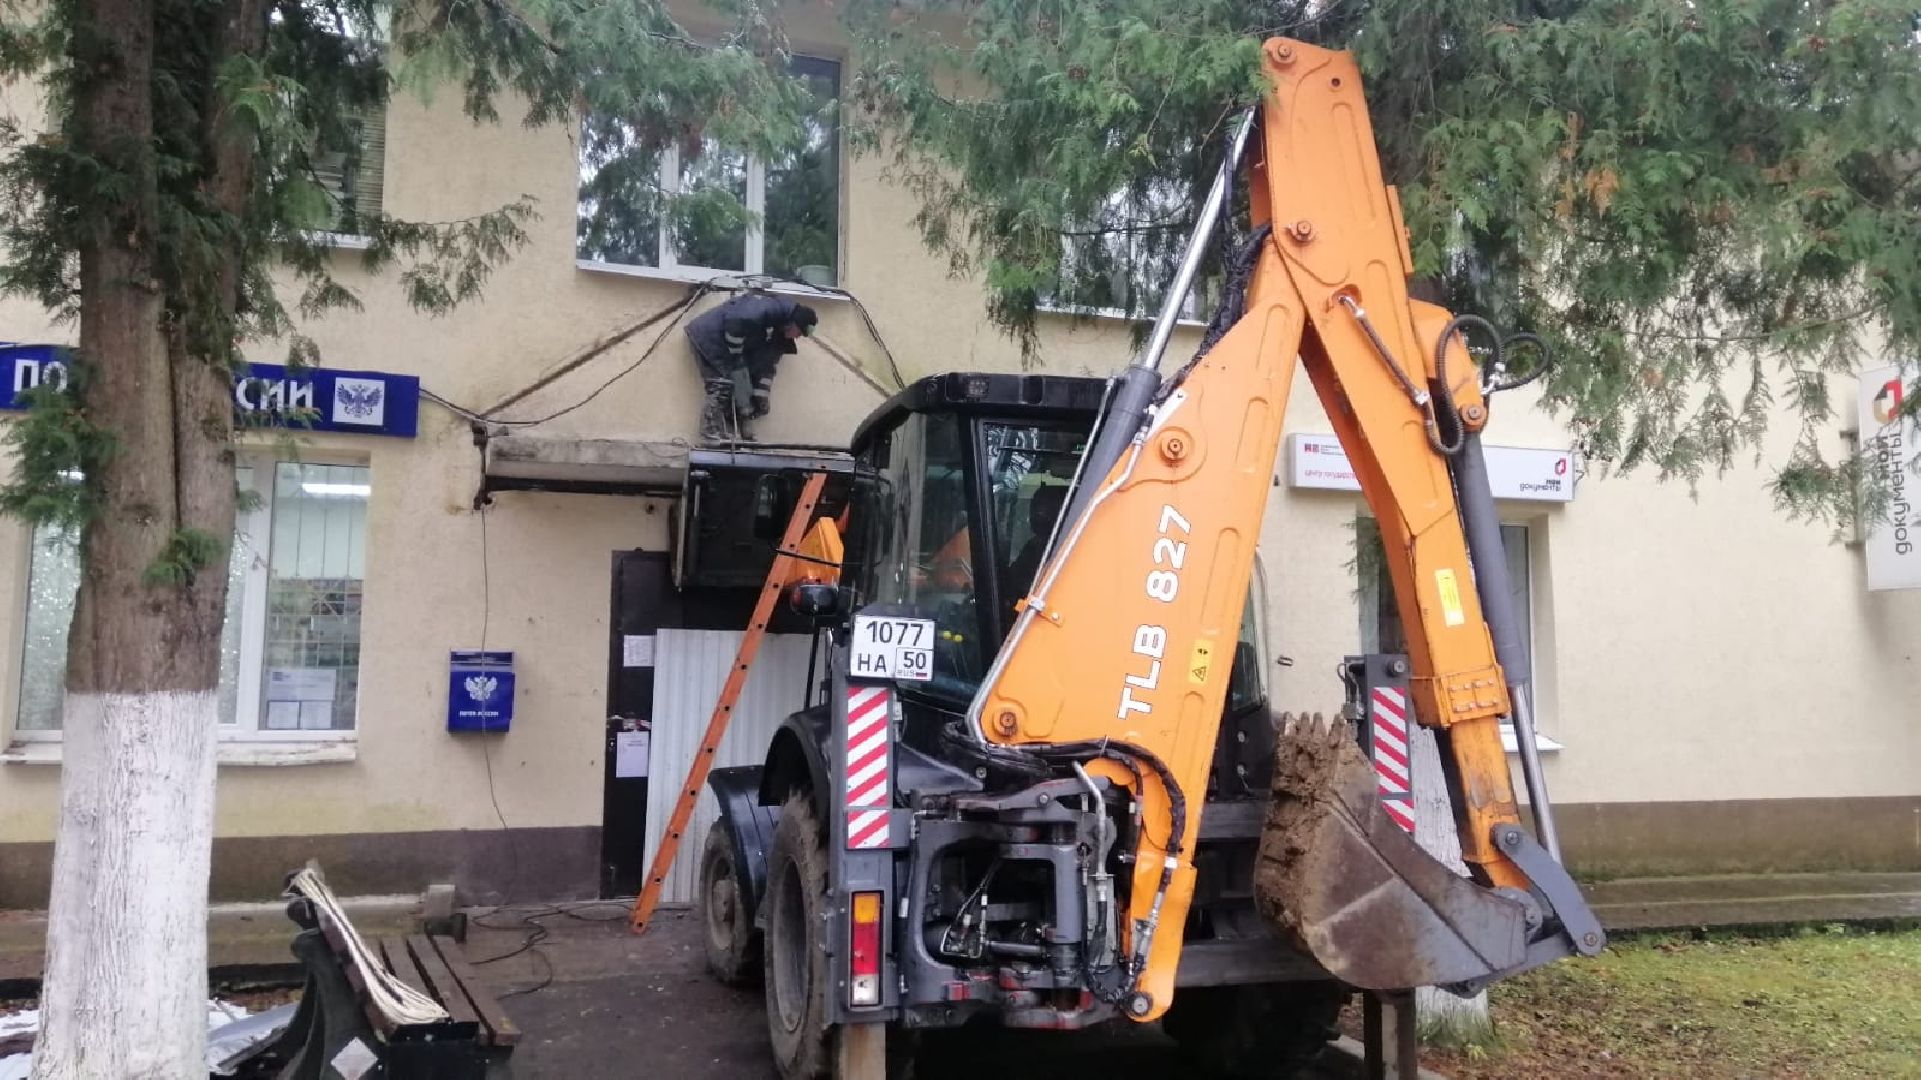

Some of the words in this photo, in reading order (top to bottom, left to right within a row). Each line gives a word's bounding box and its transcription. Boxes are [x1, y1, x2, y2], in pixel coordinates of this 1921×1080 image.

[13, 359, 68, 395] ПО
[235, 376, 314, 413] СИИ
[1889, 431, 1913, 556] документы
[866, 620, 924, 647] 1077
[1117, 623, 1168, 720] TLB
[1146, 503, 1192, 602] 827
[903, 651, 927, 670] 50
